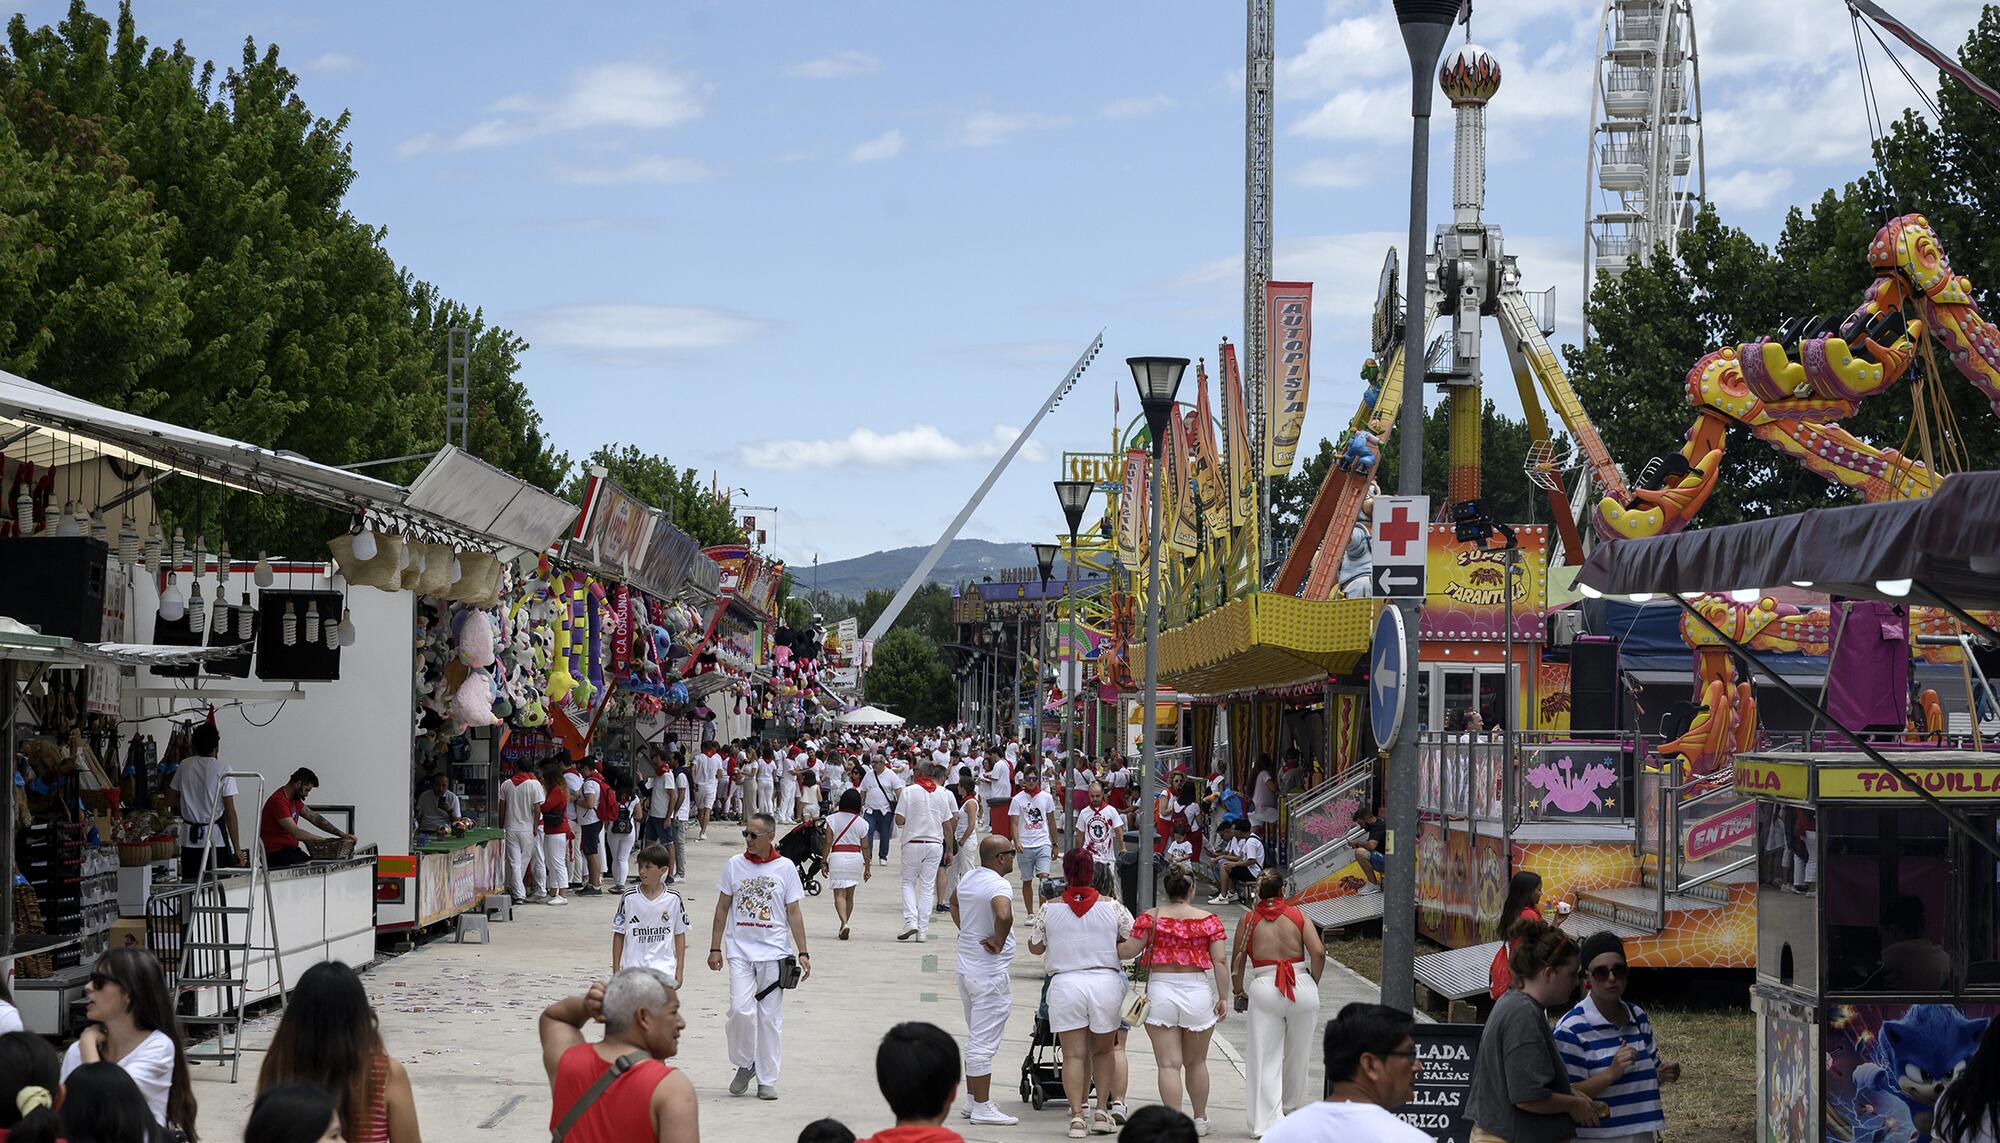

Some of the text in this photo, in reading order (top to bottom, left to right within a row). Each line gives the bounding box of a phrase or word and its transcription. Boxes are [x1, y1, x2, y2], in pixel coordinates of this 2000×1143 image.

[1281, 303, 1304, 413] AUTOPISTA
[1457, 549, 1507, 567] SUPE
[616, 593, 628, 636] OSASUNA
[1736, 768, 1781, 791] UILLA
[632, 926, 671, 937] Emirates
[1414, 1043, 1470, 1060] LADA
[1423, 1072, 1470, 1080] SALSAS
[1406, 1091, 1460, 1106] LLAS
[1393, 1113, 1449, 1128] ORIZO
